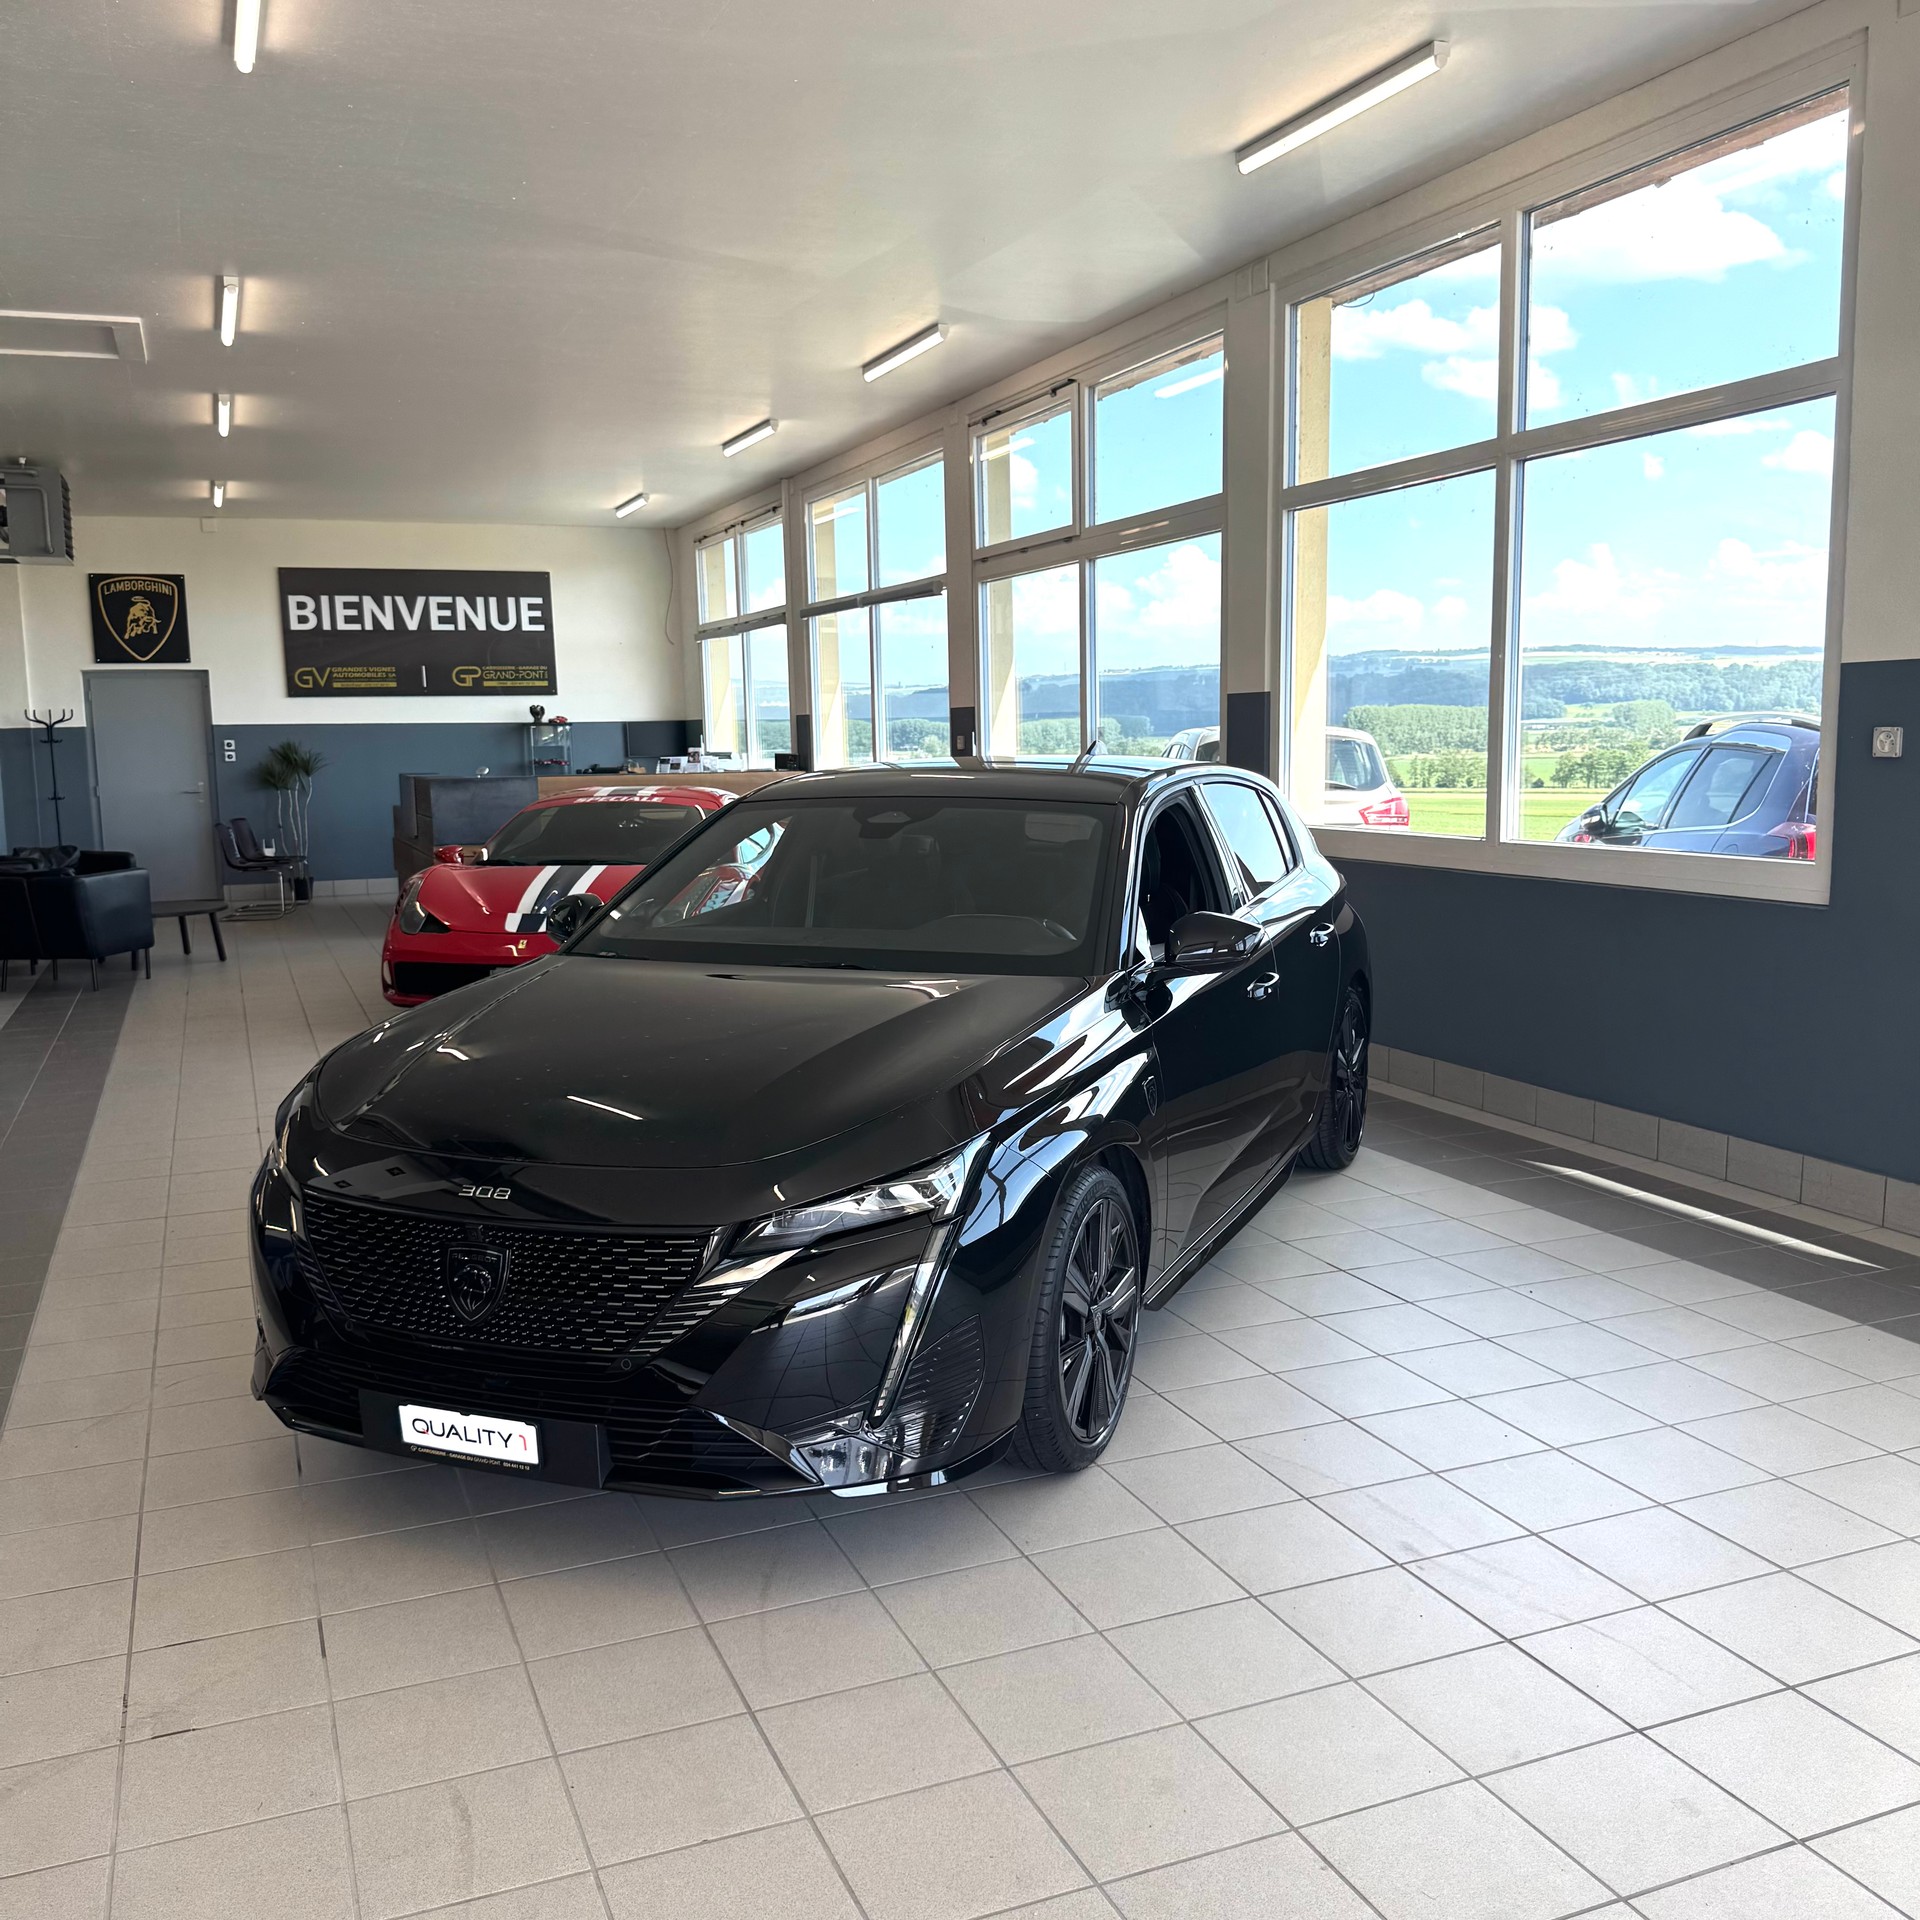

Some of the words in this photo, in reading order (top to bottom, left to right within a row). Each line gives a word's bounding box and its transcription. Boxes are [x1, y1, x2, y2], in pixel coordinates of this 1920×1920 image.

[104, 580, 173, 596] LAMBORGHINI
[287, 595, 546, 632] BIENVENUE
[294, 667, 331, 688] GV
[483, 671, 544, 679] GRAND-PONT
[458, 1184, 511, 1200] 308
[411, 1418, 513, 1449] QUALITY
[518, 1434, 528, 1452] 1
